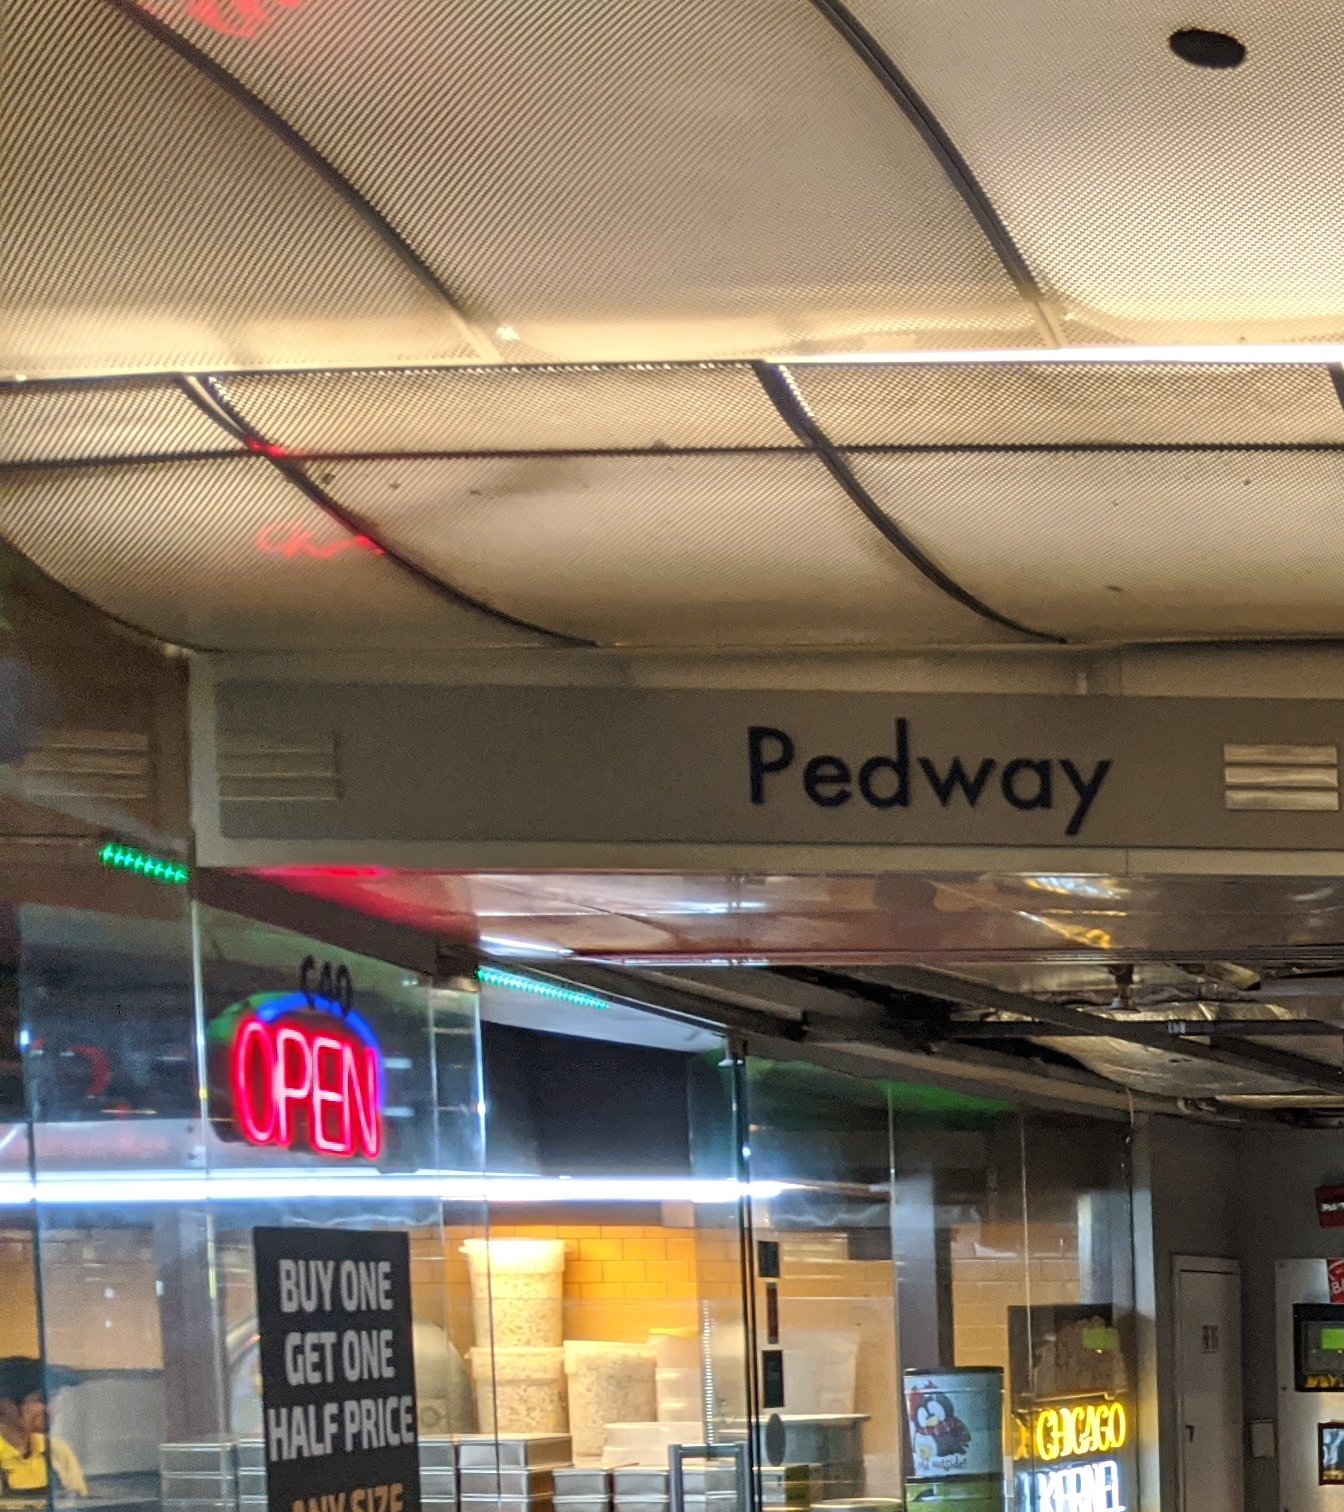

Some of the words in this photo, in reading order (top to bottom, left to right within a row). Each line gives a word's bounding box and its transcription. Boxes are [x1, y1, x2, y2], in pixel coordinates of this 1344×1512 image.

[747, 716, 1112, 837] Pedway
[233, 1013, 383, 1161] OPEN
[278, 1258, 335, 1314] BUY
[339, 1259, 394, 1313] ONE
[284, 1331, 338, 1386] GET
[342, 1329, 396, 1382] ONE
[267, 1403, 340, 1462] HALF
[344, 1395, 416, 1453] PRICE
[1037, 1402, 1127, 1461] CHICAGO
